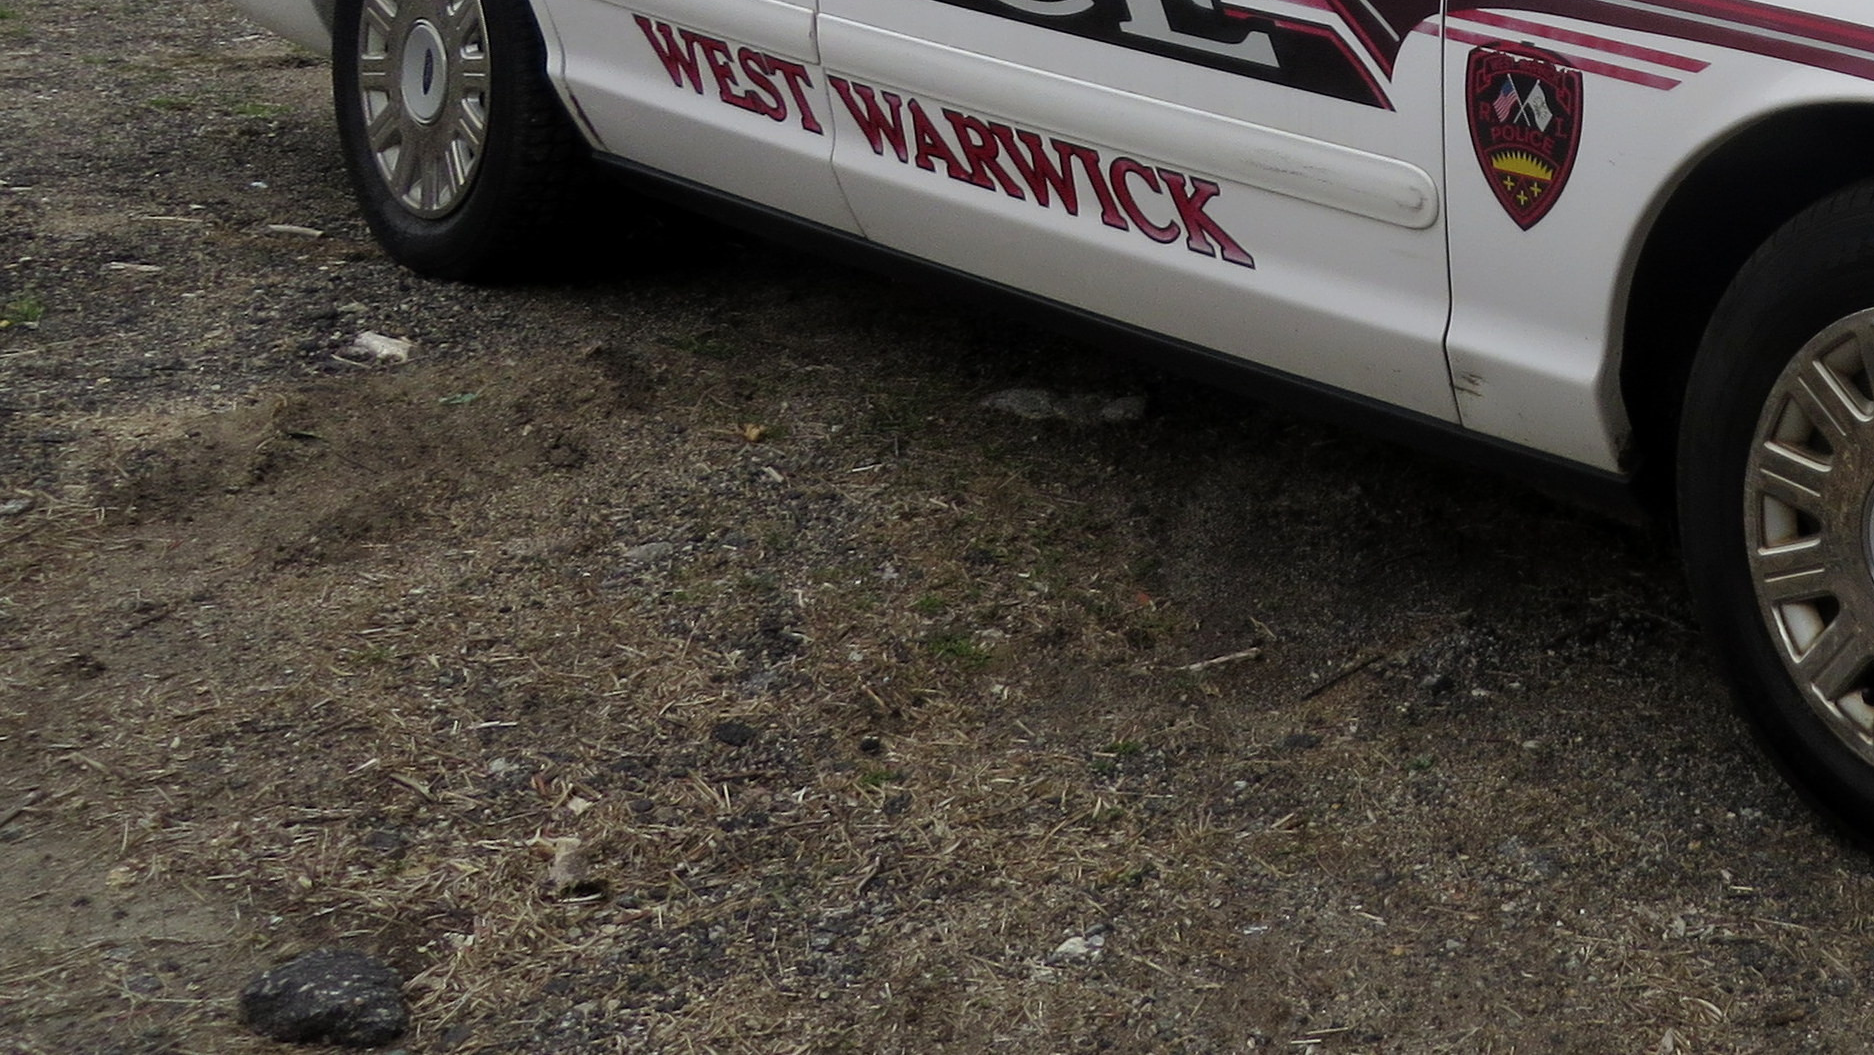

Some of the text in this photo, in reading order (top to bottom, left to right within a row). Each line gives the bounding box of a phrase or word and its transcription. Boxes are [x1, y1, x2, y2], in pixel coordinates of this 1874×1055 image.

[632, 14, 1256, 270] WEST WARWICK
[1490, 124, 1556, 152] POLICE
